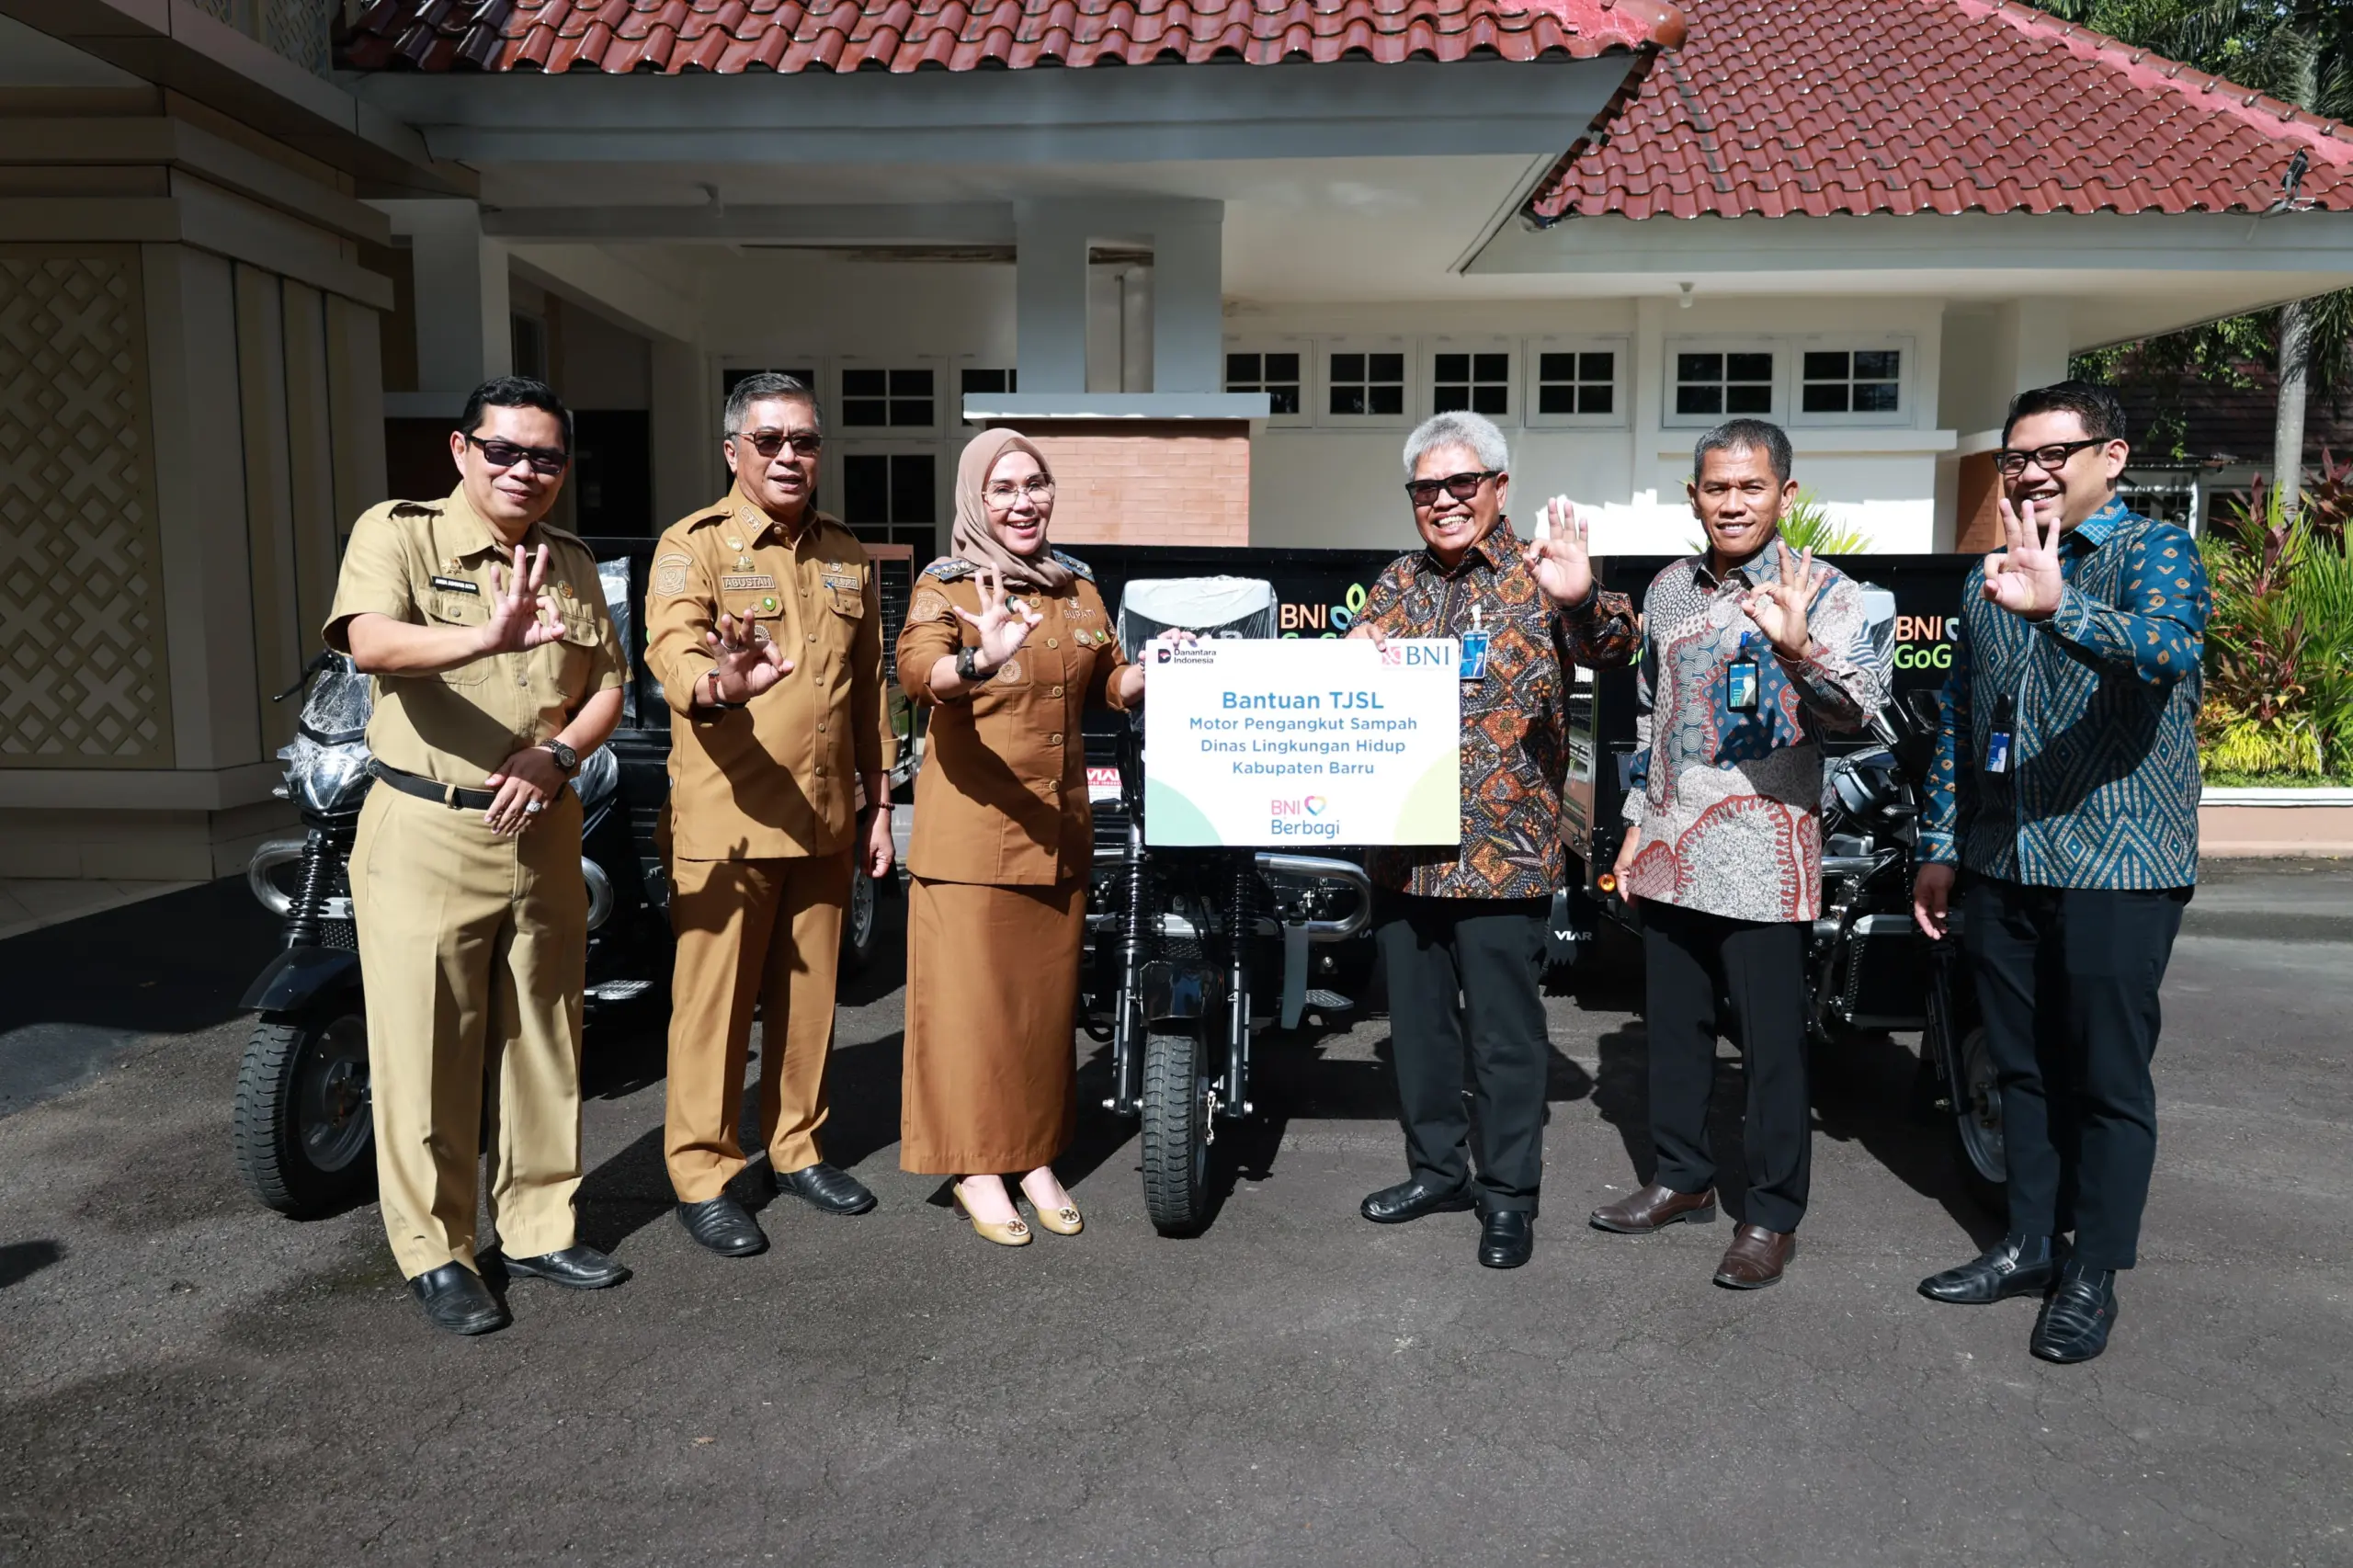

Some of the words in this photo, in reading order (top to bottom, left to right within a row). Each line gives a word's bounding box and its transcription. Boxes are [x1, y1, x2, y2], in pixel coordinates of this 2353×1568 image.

[1280, 604, 1326, 630] BNI
[1895, 616, 1942, 641] BNI
[1174, 648, 1217, 656] Danantara
[1406, 646, 1449, 665] BNI
[1174, 656, 1214, 665] Indonesia
[1222, 691, 1321, 710] Bantuan
[1329, 691, 1385, 710] TJSL
[1189, 717, 1239, 731] Motor
[1245, 717, 1345, 733] Pengangkut
[1350, 717, 1417, 733] Sampah
[1200, 739, 1246, 753] Dinas
[1252, 739, 1350, 756] Lingkungan
[1356, 739, 1406, 755] Hidup
[1233, 761, 1324, 777] Kabupaten
[1329, 761, 1374, 775] Barru
[1271, 801, 1301, 815] BNI
[1271, 819, 1340, 839] Berbagi
[1553, 930, 1593, 941] VIAR
